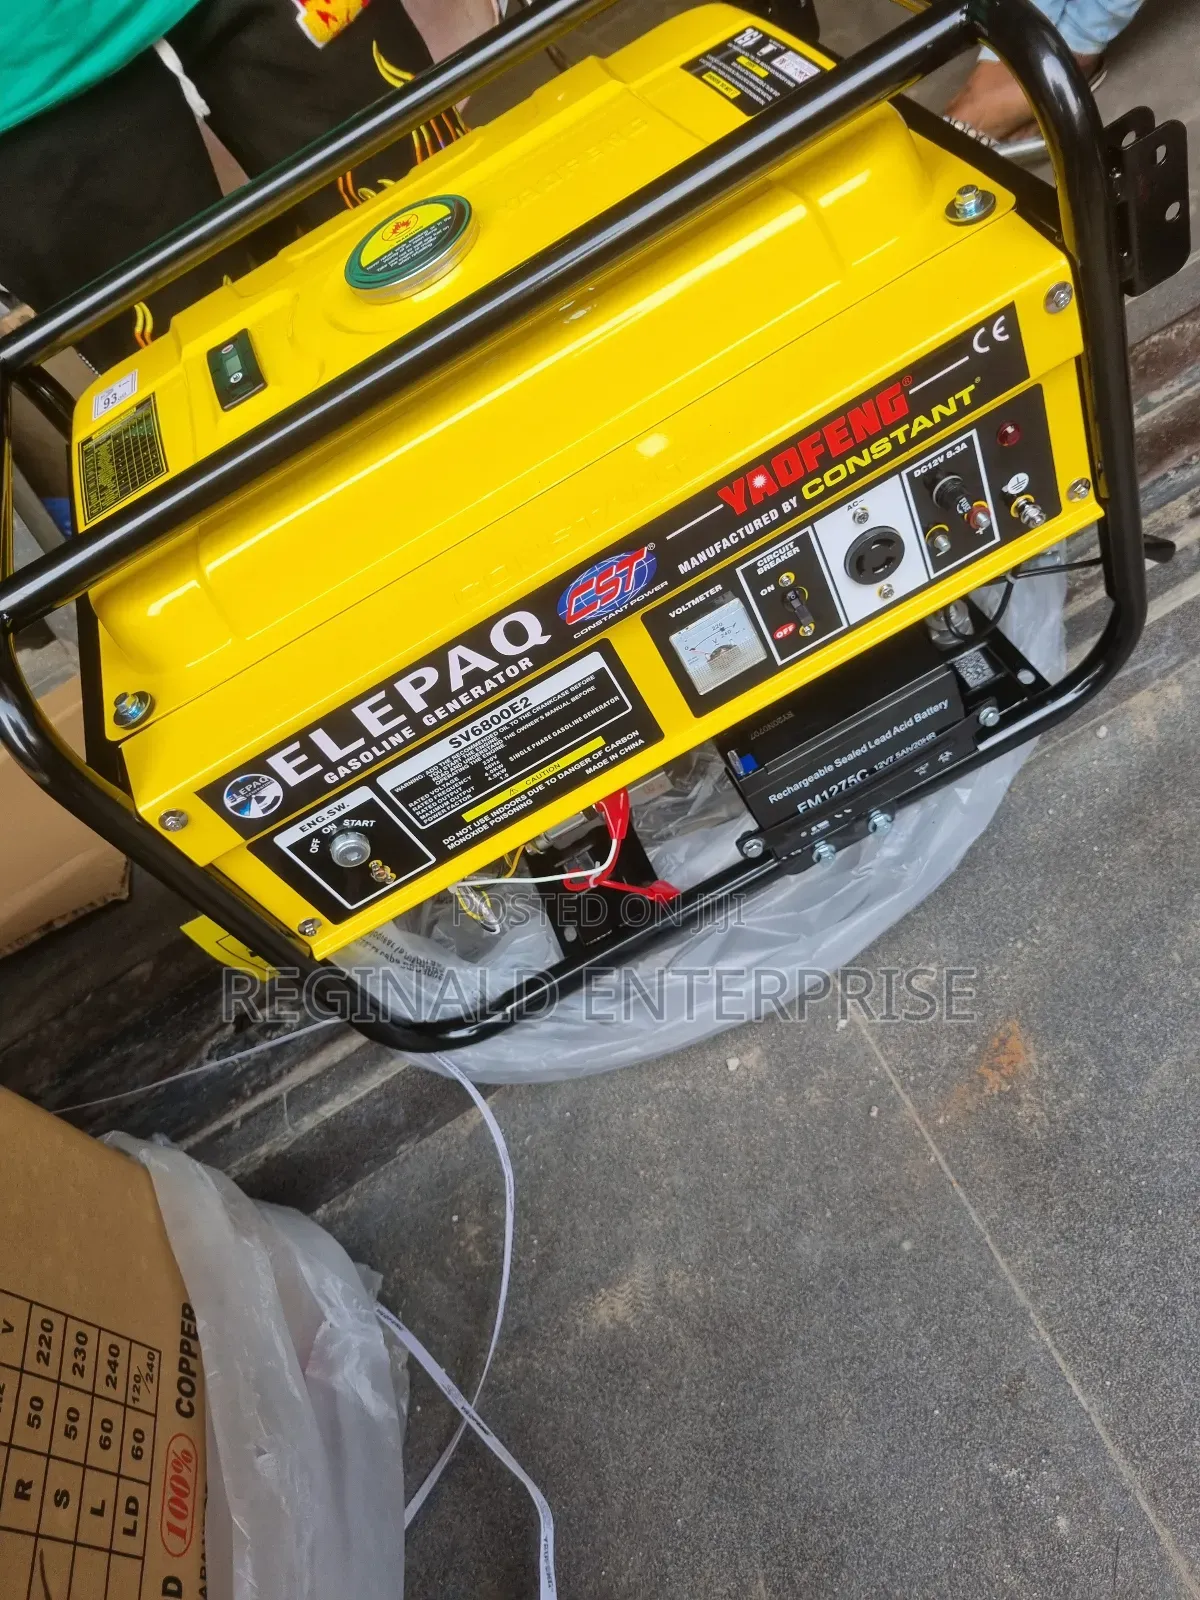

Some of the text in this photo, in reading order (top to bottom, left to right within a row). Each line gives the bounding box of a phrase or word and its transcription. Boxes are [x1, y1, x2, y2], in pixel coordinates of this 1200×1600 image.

[972, 315, 1009, 352] CE
[717, 381, 911, 515] YAOFENG
[913, 442, 968, 477] DC12V 8.3A
[678, 383, 973, 573] MANUFACTURED BY CONSTANT
[756, 541, 794, 567] CIRCUIT
[756, 546, 800, 574] BREAKER
[566, 546, 646, 625] CST
[668, 583, 722, 618] VOLTMETER
[759, 583, 775, 596] ON
[573, 580, 668, 639] CONSTANT POWER
[775, 623, 794, 638] OFF
[265, 611, 551, 787] ELEPAQ
[519, 711, 531, 721] THE
[323, 656, 534, 785] GASOLINE GENERATOR
[449, 695, 531, 750] SV6800E2
[504, 731, 515, 740] THE
[586, 738, 643, 774] MADE IN CHINA
[768, 698, 948, 804] Rechargeable Sealed Lead Acid Battery
[409, 793, 429, 807] RATED
[430, 776, 459, 795] VOLTAGE
[442, 730, 638, 844] DO NOT USE INDOORS DUE TO DANGER OF CARBON
[526, 763, 559, 785] CAUTION
[413, 797, 433, 811] RATED
[416, 802, 436, 815] RATED
[438, 787, 462, 803] OUTPUT
[423, 808, 446, 823] POWER
[447, 793, 471, 810] FACTOR
[450, 786, 475, 802] OUTPUT
[321, 822, 337, 833] ON
[342, 818, 376, 826] START
[448, 798, 532, 850] MONOXIDE POISONING
[309, 838, 320, 853] OFF
[2, 1318, 15, 1334] V
[36, 1317, 54, 1367] 220
[72, 1330, 89, 1380] 230
[105, 1343, 121, 1391] 240
[26, 1395, 45, 1430] 50
[64, 1406, 81, 1441] 50
[98, 1417, 114, 1452] 60
[131, 1427, 146, 1461] 60
[14, 1478, 33, 1502] R
[54, 1488, 70, 1510] S
[166, 1450, 193, 1545] 100%
[90, 1499, 106, 1518] L
[122, 1495, 140, 1538] LD
